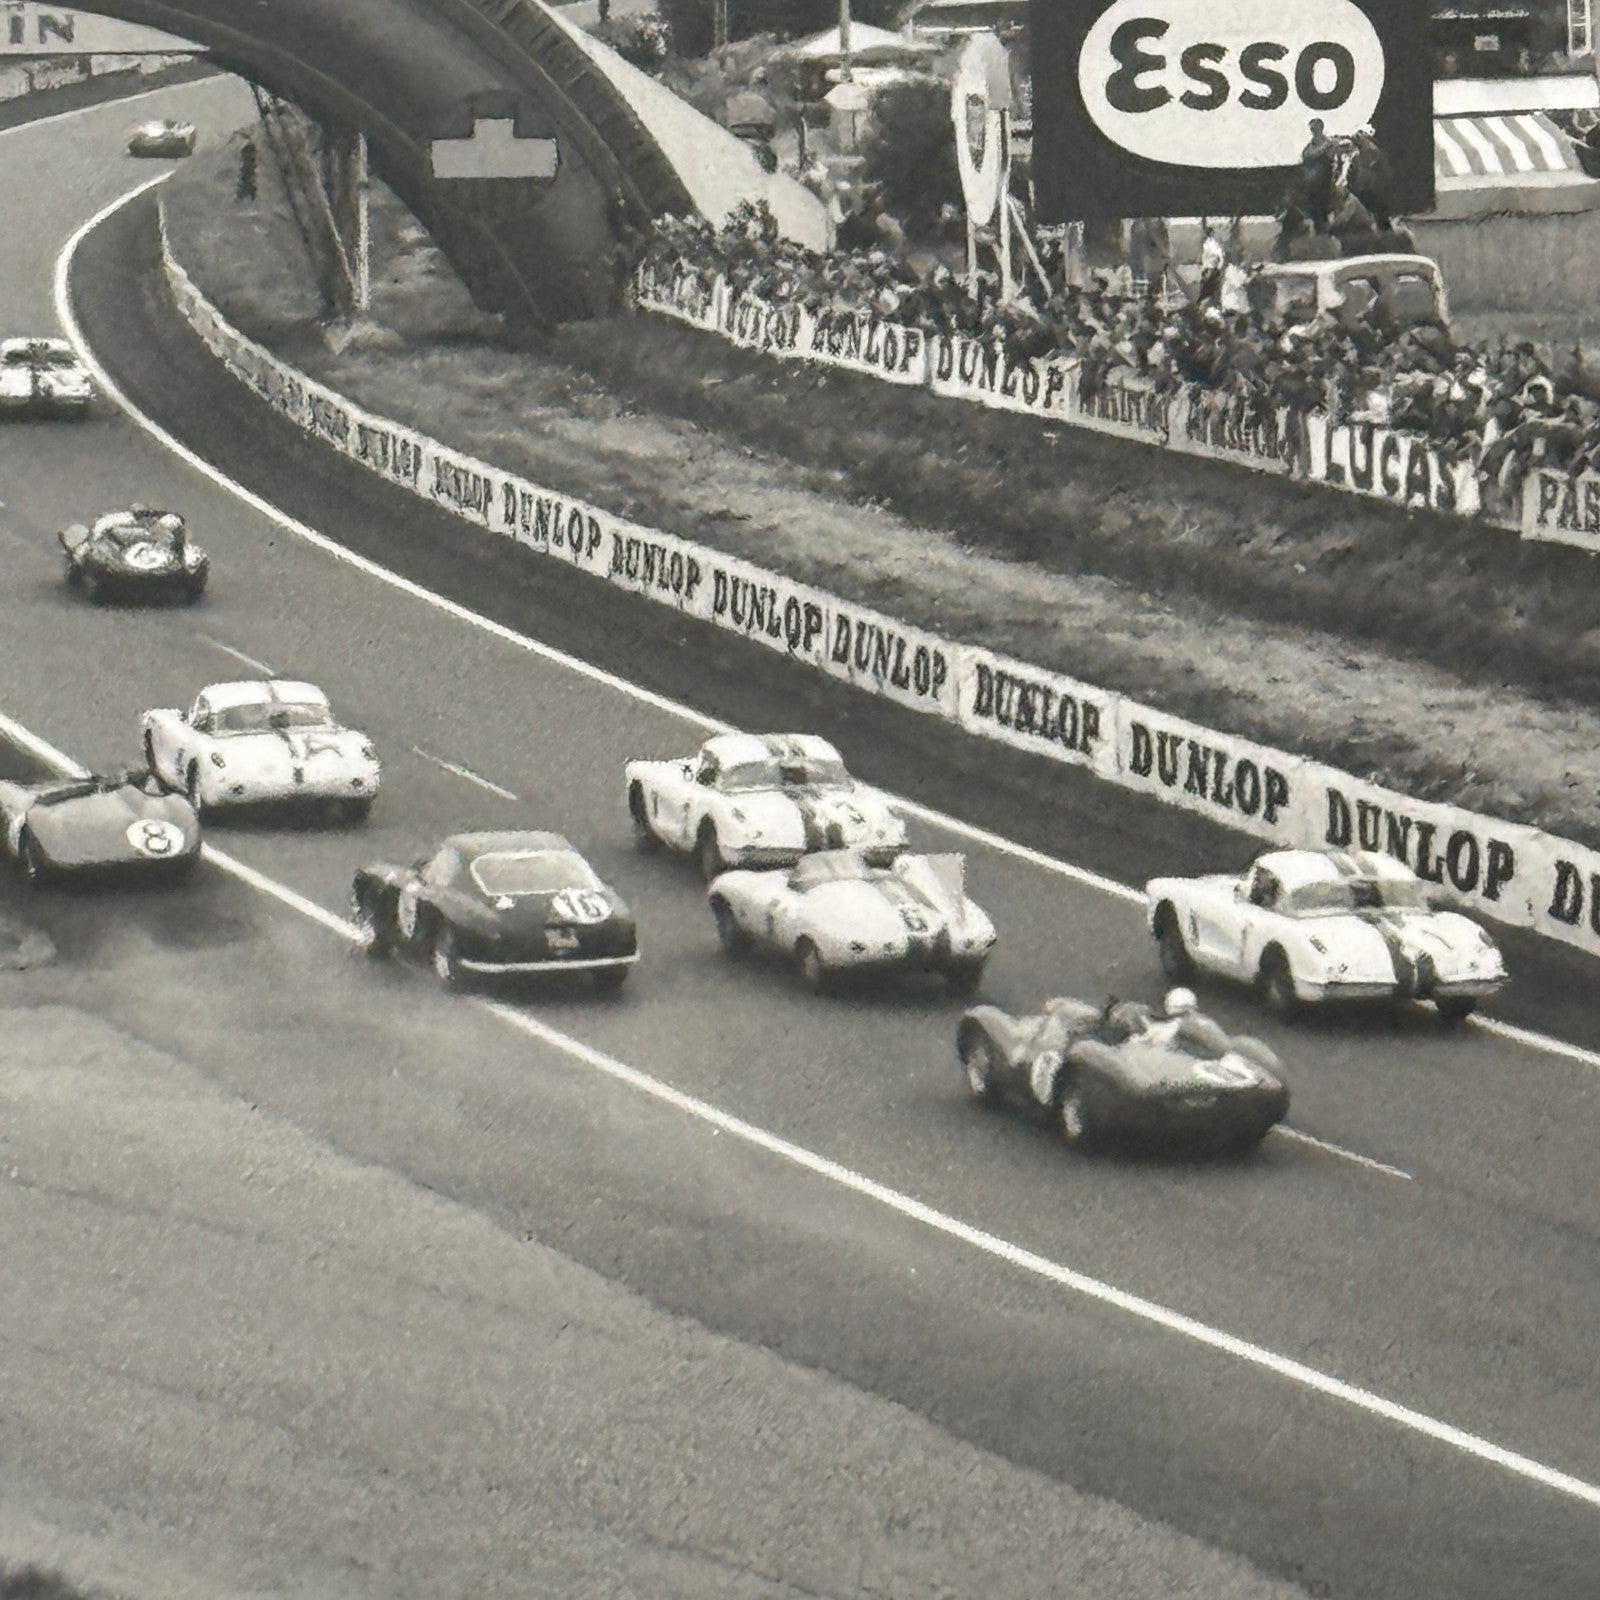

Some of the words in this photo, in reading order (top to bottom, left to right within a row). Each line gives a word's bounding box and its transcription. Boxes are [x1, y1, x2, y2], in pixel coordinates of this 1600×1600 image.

[1104, 18, 1355, 113] Esso
[503, 481, 602, 560] DUNLOP
[713, 568, 823, 651] DUNLOP
[832, 613, 948, 699] DUNLOP
[974, 662, 1101, 755] DUNLOP
[1131, 721, 1290, 825] DUNLOP
[1325, 787, 1515, 901] DUNLOP
